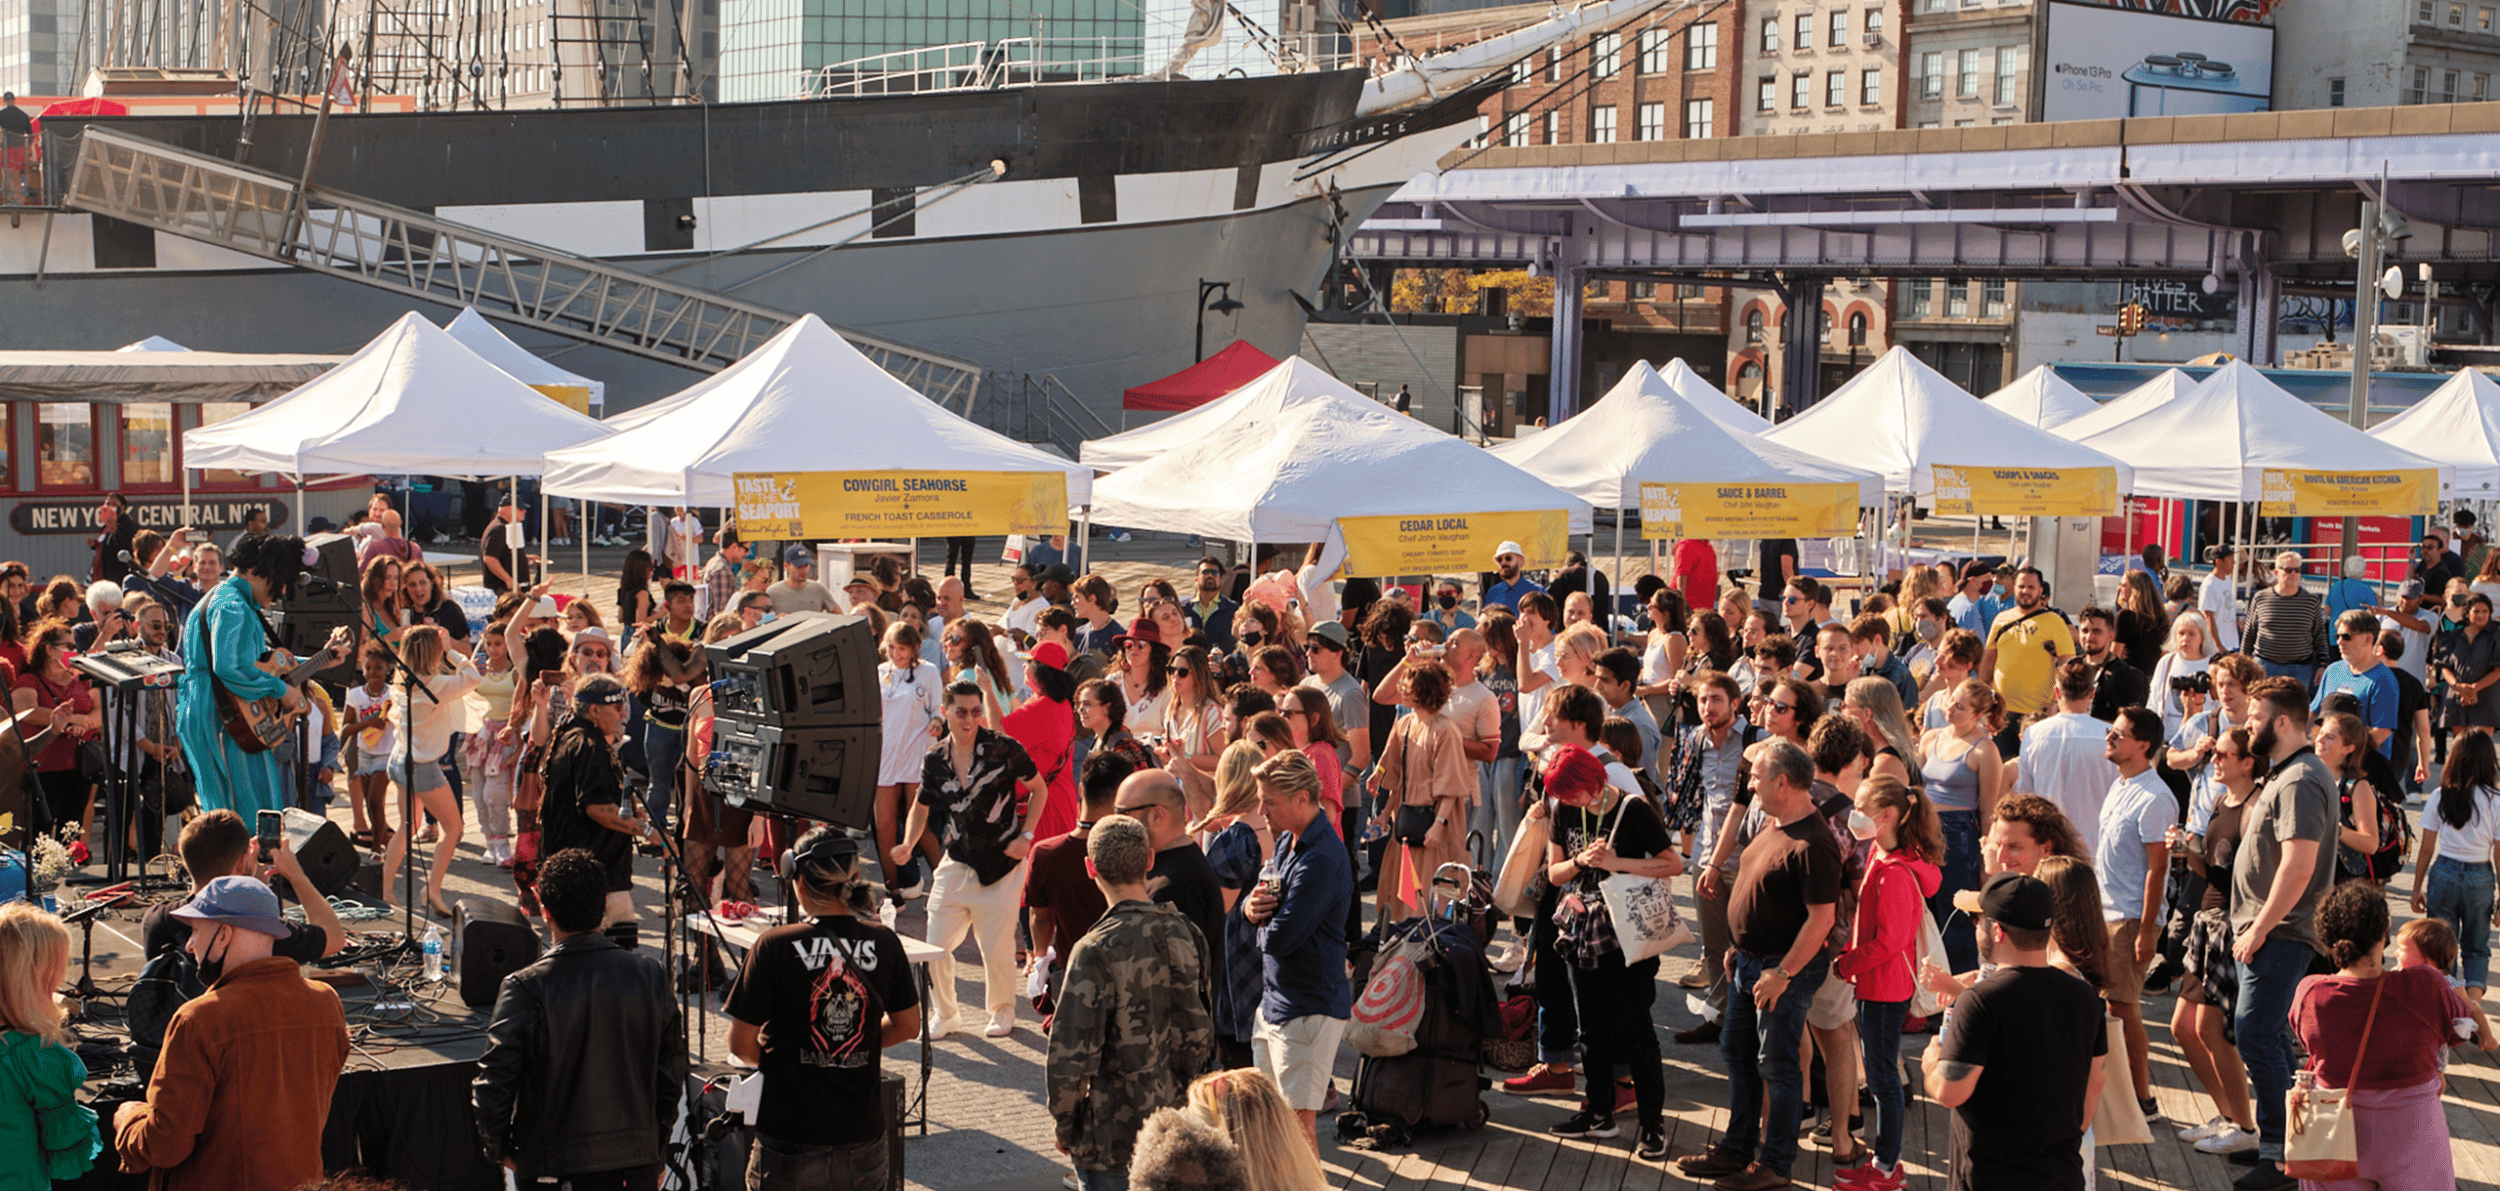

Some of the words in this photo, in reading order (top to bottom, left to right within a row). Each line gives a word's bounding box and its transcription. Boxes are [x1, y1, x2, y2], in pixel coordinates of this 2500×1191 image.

[2062, 63, 2088, 76] iPhone
[2089, 66, 2098, 78] 13
[2099, 66, 2112, 79] Pro
[2133, 289, 2203, 312] MATTER
[737, 478, 777, 493] TASTE
[843, 478, 898, 492] COWGIRL
[903, 478, 967, 491] SEAHORSE
[2336, 475, 2371, 484] AMERICAN
[2372, 475, 2401, 483] KITCHEN
[738, 493, 753, 503] OF
[756, 493, 777, 503] THE
[874, 494, 901, 502] Javier
[903, 493, 940, 502] Zamora
[1642, 487, 1667, 500] TASTE
[1717, 487, 1743, 498] SAUCE
[1746, 487, 1752, 498] &
[1754, 487, 1787, 498] BARREL
[739, 502, 801, 520] SEAPORT
[1754, 501, 1781, 510] Vaughan
[32, 507, 79, 528] NEW
[81, 506, 134, 528] YO
[138, 504, 225, 526] CENTRAL
[845, 513, 880, 521] FRENCH
[883, 512, 913, 521] TOAST
[916, 511, 973, 520] CASSEROLE
[1643, 508, 1682, 522] SEAPORT
[1400, 519, 1434, 532] CEDAR
[1436, 518, 1468, 530] LOCAL
[1418, 534, 1436, 542] John
[1438, 533, 1470, 542] Vaughan
[792, 937, 878, 971] VANS
